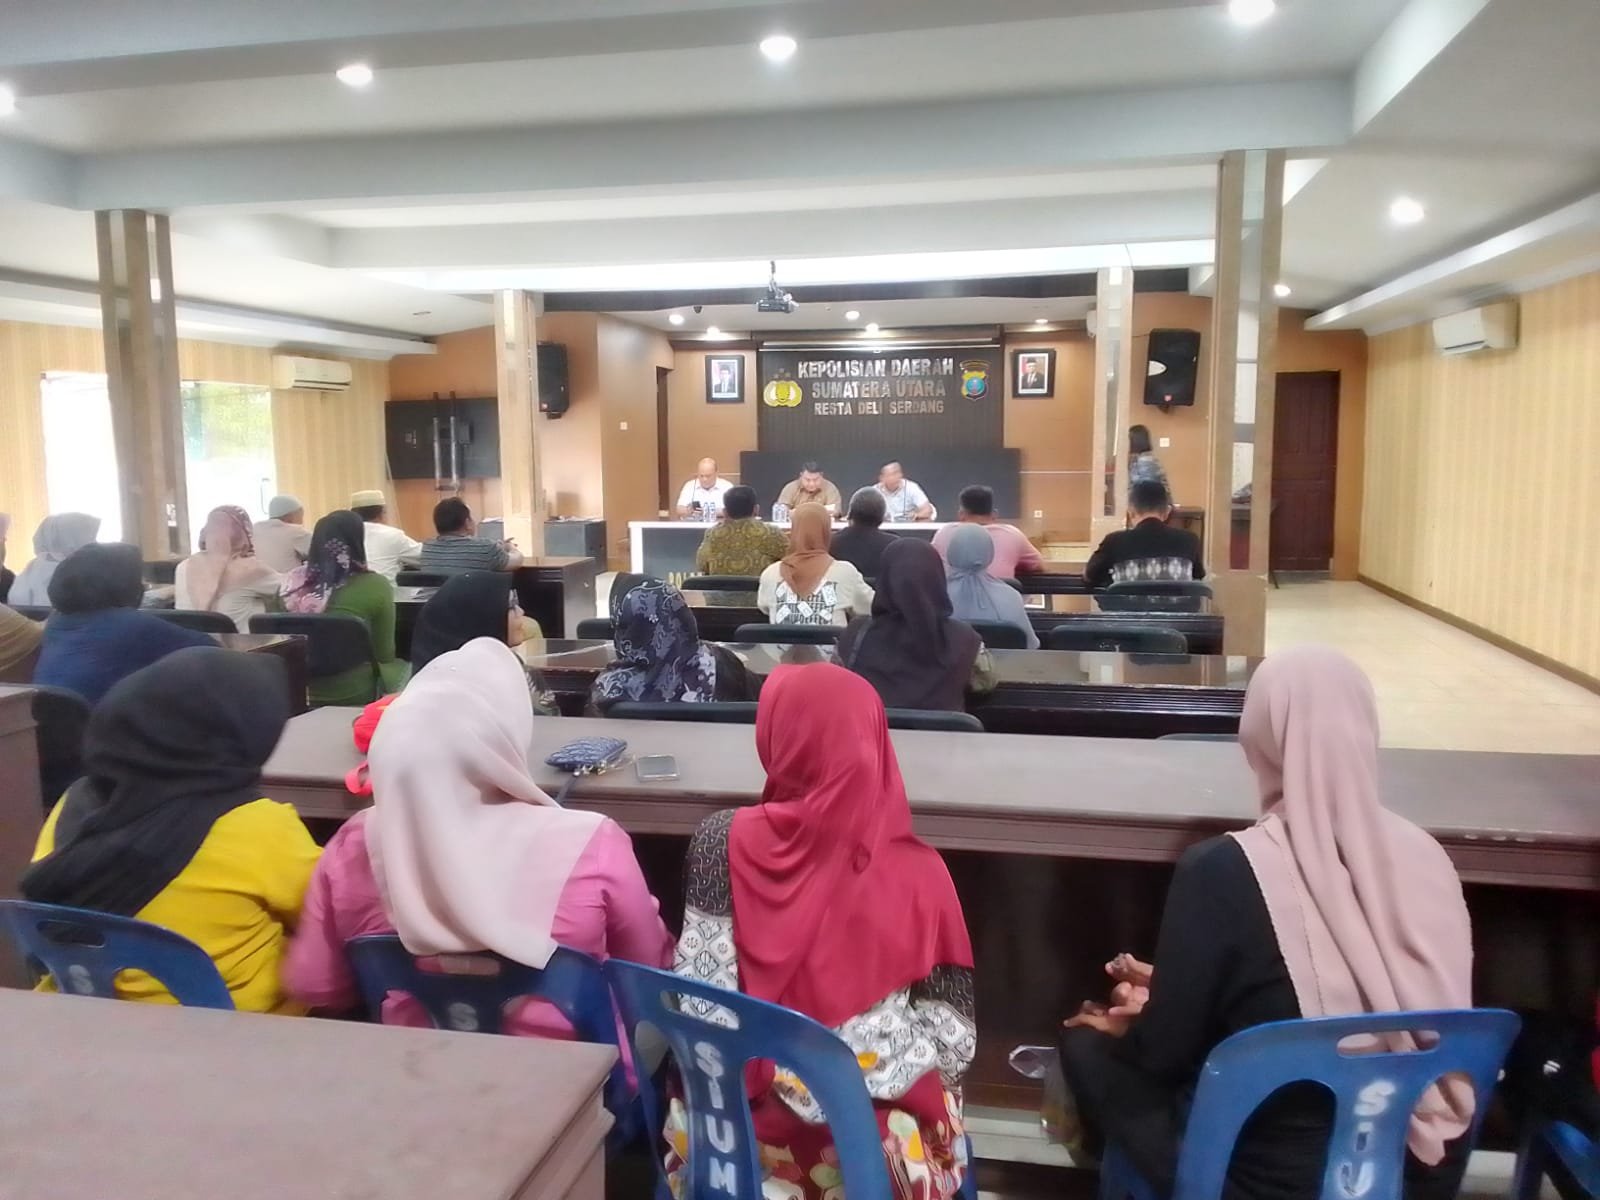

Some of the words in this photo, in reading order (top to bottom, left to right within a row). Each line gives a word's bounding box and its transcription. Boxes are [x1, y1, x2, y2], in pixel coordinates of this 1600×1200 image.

[798, 359, 886, 378] KEPOLISIAN
[891, 357, 954, 377] DAERAH
[812, 380, 891, 399] SUMATERA
[896, 379, 946, 398] UTARA
[814, 401, 853, 415] RESTA
[858, 401, 883, 415] DELI
[889, 400, 945, 415] SERDANG
